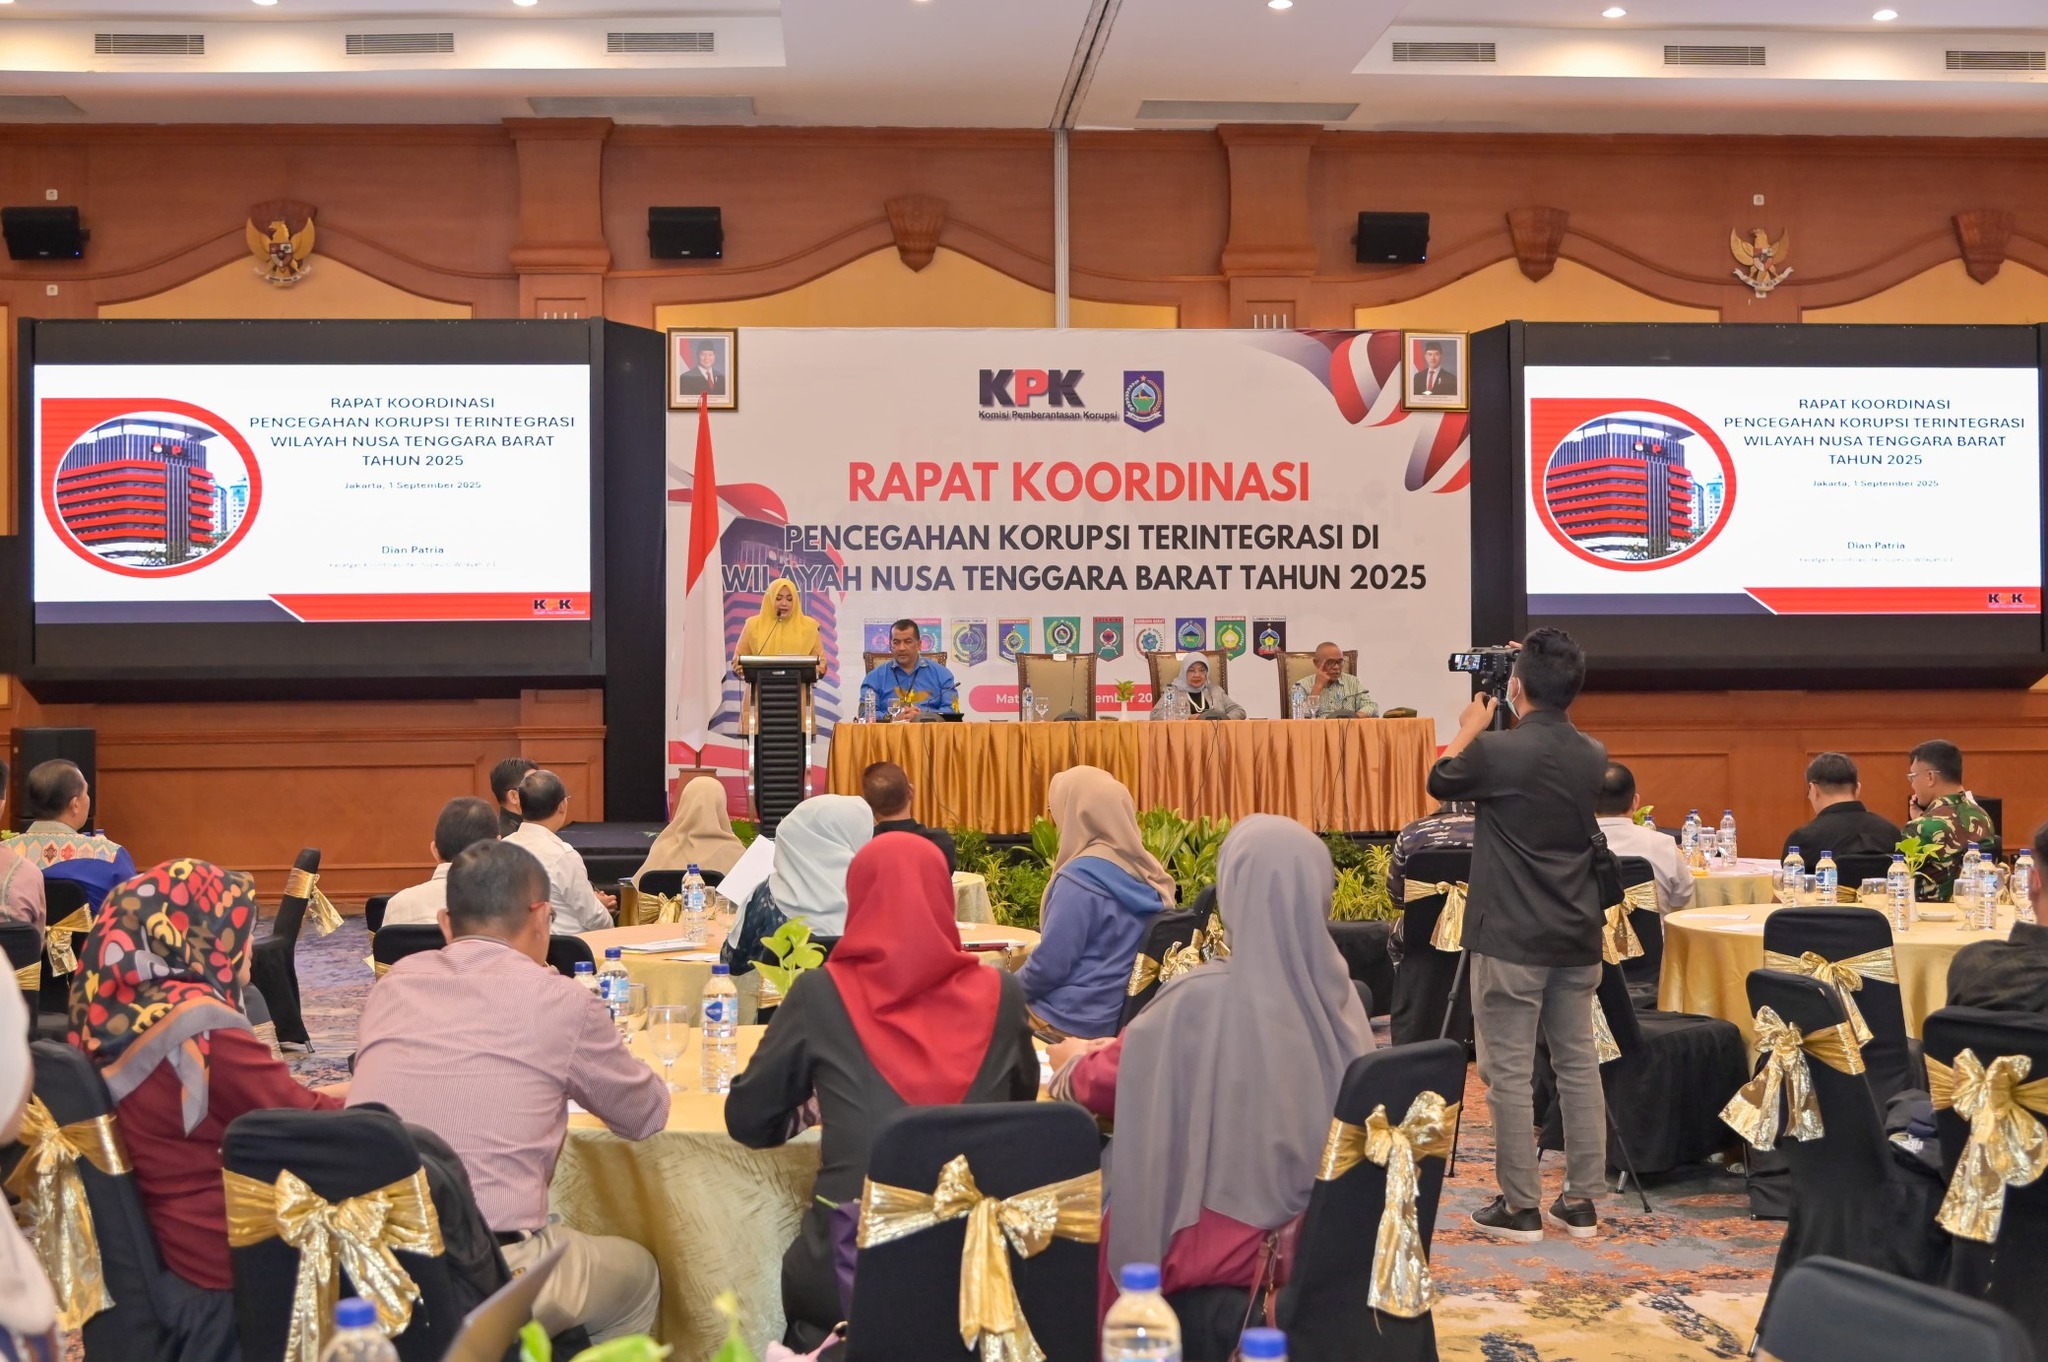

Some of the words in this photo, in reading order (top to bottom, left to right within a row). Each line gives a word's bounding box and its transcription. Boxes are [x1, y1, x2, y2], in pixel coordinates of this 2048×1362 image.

[979, 368, 1085, 408] KPK
[330, 397, 383, 409] RAPAT
[387, 397, 495, 409] KOORDINASI
[1799, 398, 1846, 410] RAPAT
[1851, 399, 1951, 410] KOORDINASI
[250, 417, 370, 428] PENCEGAHAN
[375, 416, 449, 428] KORUPSI
[455, 416, 575, 428] TERINTEGRASI
[978, 410, 1009, 419] Komisi
[1011, 410, 1080, 420] Pemberantasan
[1083, 411, 1118, 422] Korupsi
[1724, 417, 1835, 428] PENCEGAHAN
[1839, 417, 1909, 428] KORUPSI
[1913, 417, 2025, 429] TERINTEGRASI
[270, 436, 347, 447] WILAYAH
[352, 435, 400, 447] NUSA
[404, 435, 497, 447] TENGGARA
[501, 435, 555, 447] BARAT
[1743, 435, 1815, 447] WILAYAH
[1819, 435, 1863, 447] NUSA
[1867, 435, 1953, 447] TENGGARA
[1957, 435, 2006, 447] BARAT
[362, 455, 420, 466] TAHUN
[425, 455, 464, 466] 2025
[1828, 454, 1883, 465] TAHUN
[1887, 454, 1923, 465] 2025
[396, 481, 454, 491] September
[457, 481, 482, 489] 2025
[849, 462, 998, 501] RAPAT
[1014, 461, 1308, 501] KOORDINASI
[1916, 480, 1939, 488] 2025
[786, 525, 989, 551] PENCEGAHAN
[999, 524, 1129, 551] KORUPSI
[1137, 524, 1342, 550] TERINTEGRASI
[1352, 524, 1379, 550] DI
[381, 545, 408, 554] Dian
[411, 545, 444, 554] Patria
[1847, 541, 1872, 550] Dian
[1875, 541, 1906, 550] Patria
[722, 566, 862, 592] WILAYAH
[871, 565, 955, 592] NUSA
[963, 564, 1128, 591] TENGGARA
[1135, 564, 1232, 591] BARAT
[1240, 564, 1341, 591] TAHUN
[1350, 563, 1427, 590] 2025
